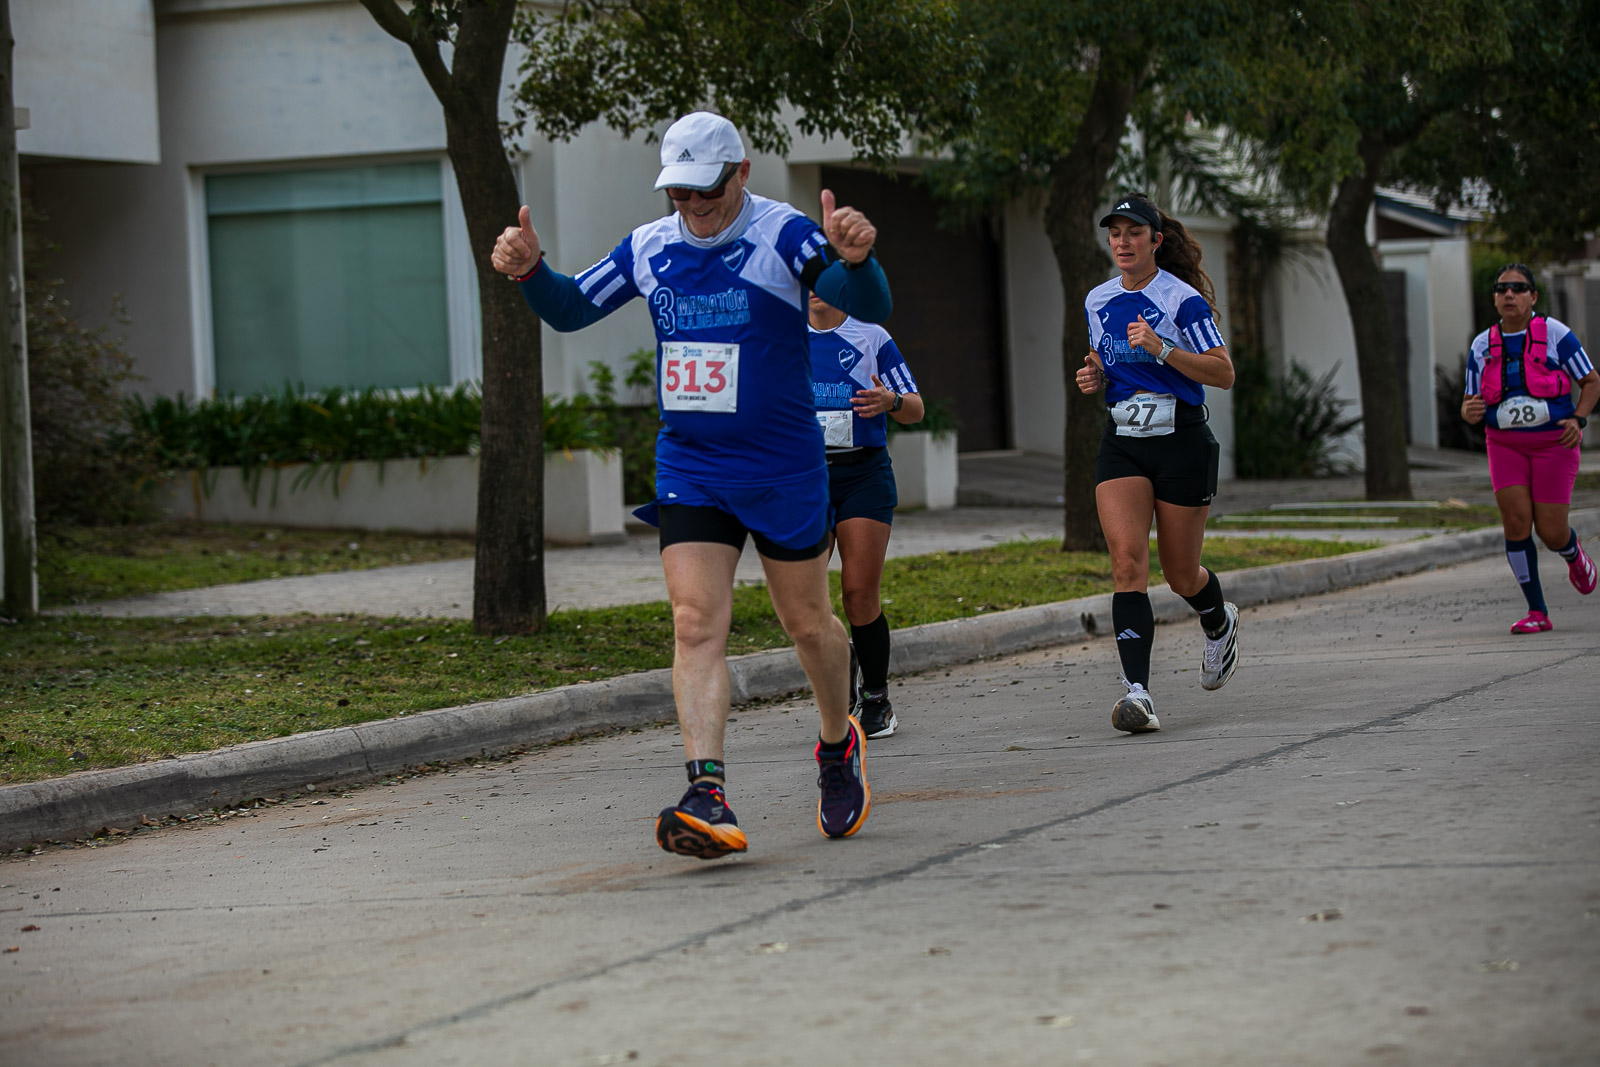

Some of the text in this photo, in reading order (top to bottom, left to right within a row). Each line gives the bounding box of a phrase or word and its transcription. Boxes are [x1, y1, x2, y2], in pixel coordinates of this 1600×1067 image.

[654, 286, 749, 336] 3 MARATÓN
[1102, 333, 1115, 366] 3
[665, 360, 727, 394] 513
[1125, 403, 1158, 427] 27
[1508, 405, 1537, 426] 28
